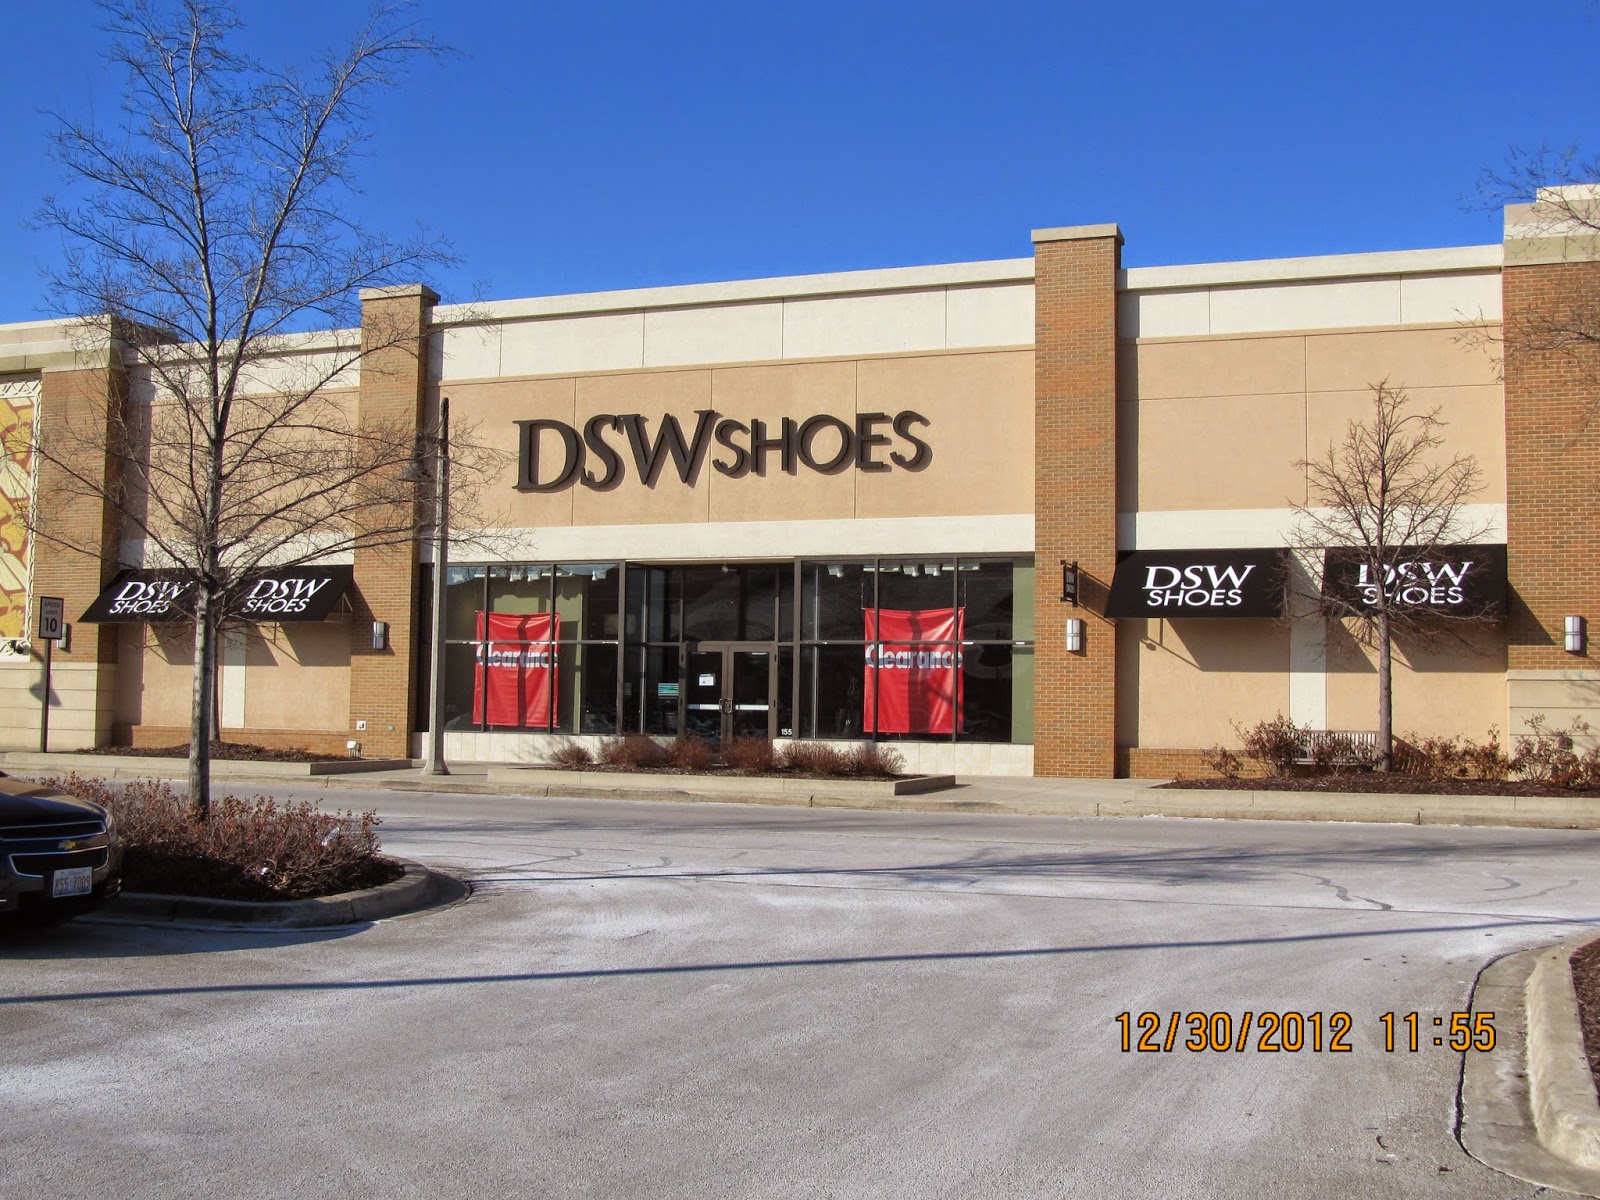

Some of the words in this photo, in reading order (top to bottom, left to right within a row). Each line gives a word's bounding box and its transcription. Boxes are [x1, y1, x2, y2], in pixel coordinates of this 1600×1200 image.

[512, 410, 721, 492] DSW
[712, 410, 932, 477] SHOES
[1142, 565, 1256, 589] DSW
[1355, 561, 1473, 587] DSW
[113, 580, 195, 600] DSW
[246, 578, 332, 599] DSW
[1146, 589, 1242, 606] SHOES
[1361, 586, 1464, 605] SHOES
[109, 600, 170, 614] SHOES
[241, 598, 310, 613] SHOES
[45, 617, 57, 632] 10
[865, 643, 963, 669] Clearance
[781, 728, 792, 736] 155
